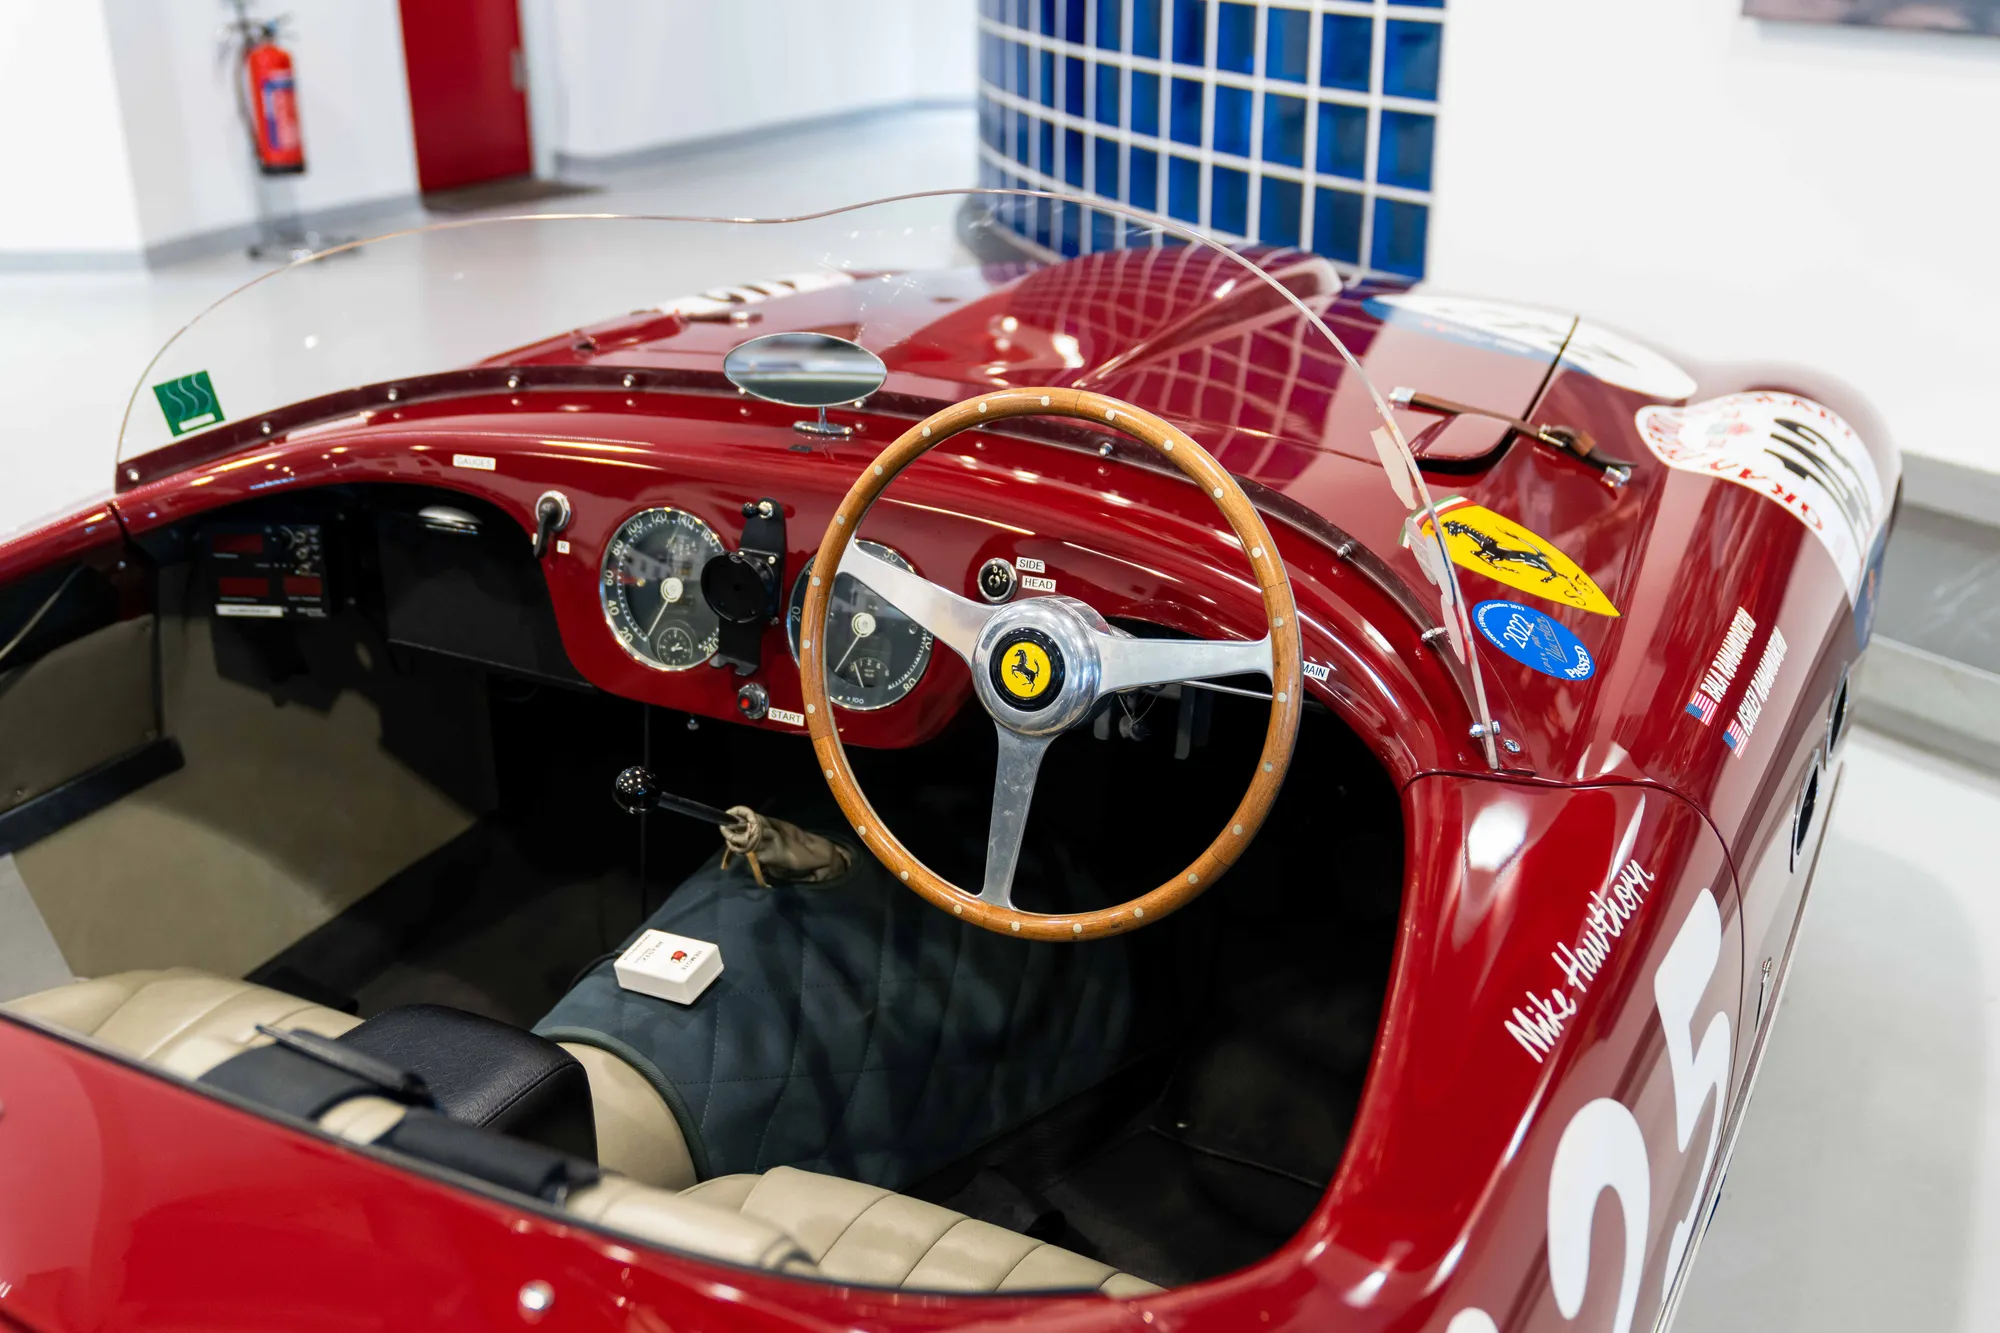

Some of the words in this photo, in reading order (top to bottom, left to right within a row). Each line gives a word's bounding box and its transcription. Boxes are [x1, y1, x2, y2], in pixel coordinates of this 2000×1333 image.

[650, 513, 668, 523] 120
[677, 513, 695, 529] 140
[626, 518, 643, 536] 100
[701, 529, 718, 546] 160
[612, 540, 624, 557] 80
[1019, 559, 1043, 570] SIDE
[605, 570, 614, 586] 60
[1024, 577, 1053, 589] HEAD
[608, 600, 620, 616] 40
[791, 606, 800, 622] 20
[619, 626, 634, 643] 20
[1503, 613, 1535, 649] 2022
[1564, 645, 1591, 679] PASSED
[902, 677, 917, 692] 80
[1700, 668, 1730, 703] BALA
[770, 709, 802, 724] START
[1737, 685, 1762, 736] ASHLEY
[1504, 986, 1578, 1063] Mike
[1551, 858, 1655, 992] Hawthorn
